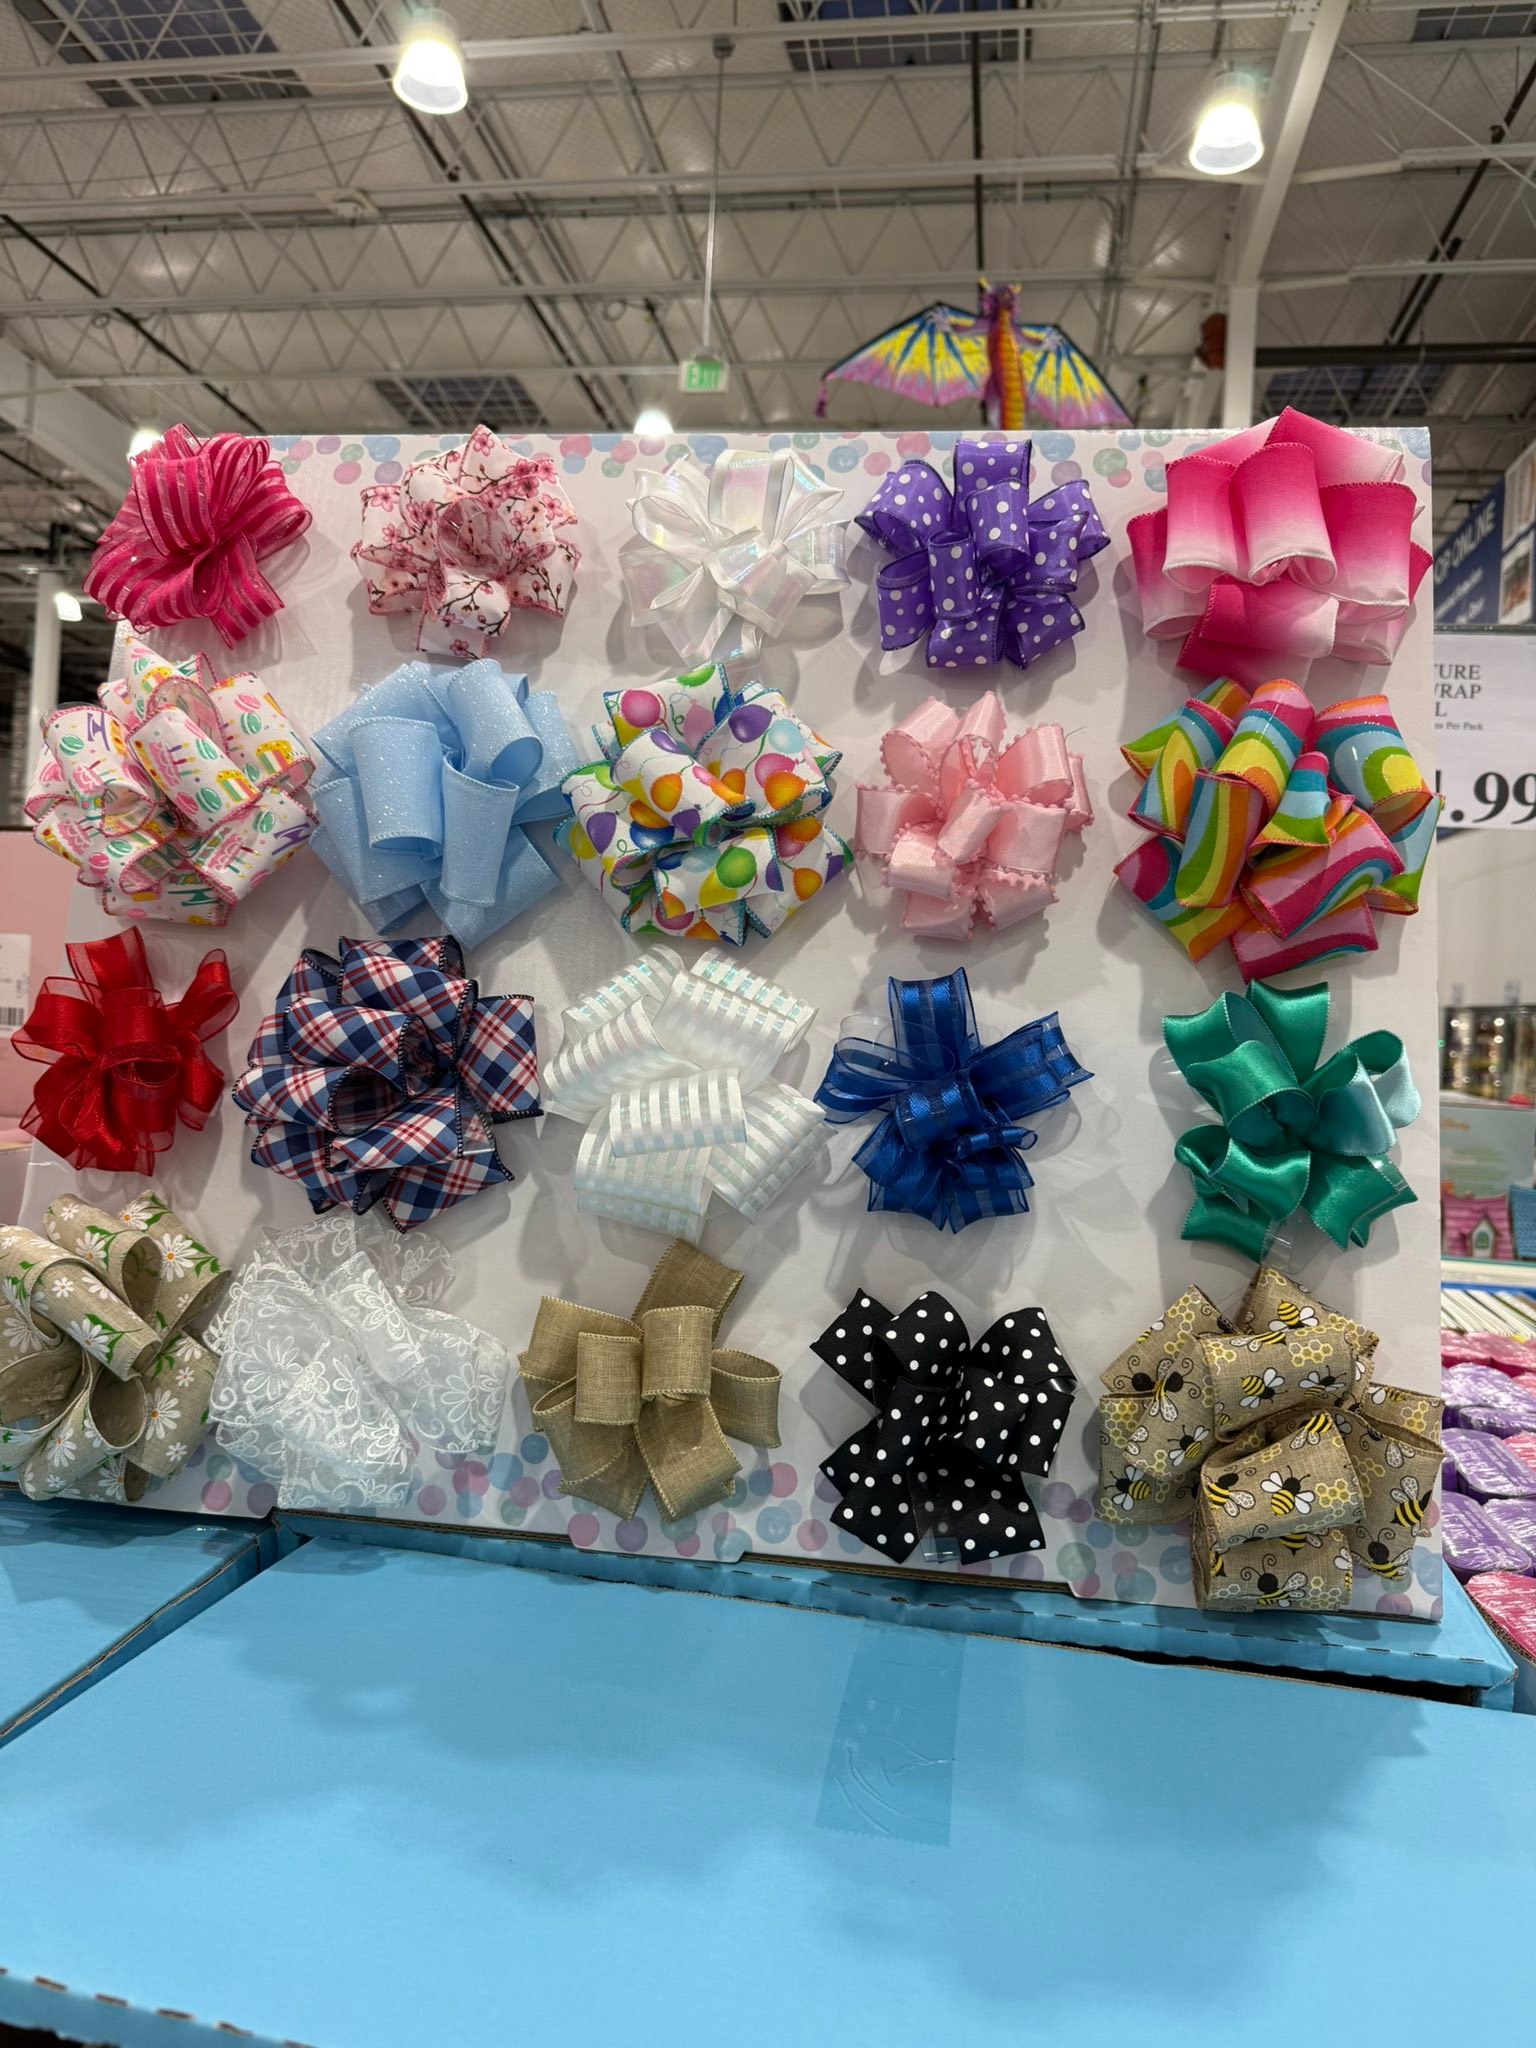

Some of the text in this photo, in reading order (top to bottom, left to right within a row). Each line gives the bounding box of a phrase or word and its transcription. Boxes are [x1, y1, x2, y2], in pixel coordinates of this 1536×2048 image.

[687, 362, 720, 391] EXIT
[1452, 499, 1496, 568] ONLINE
[1434, 664, 1480, 680] URE
[1434, 683, 1482, 699] RAP
